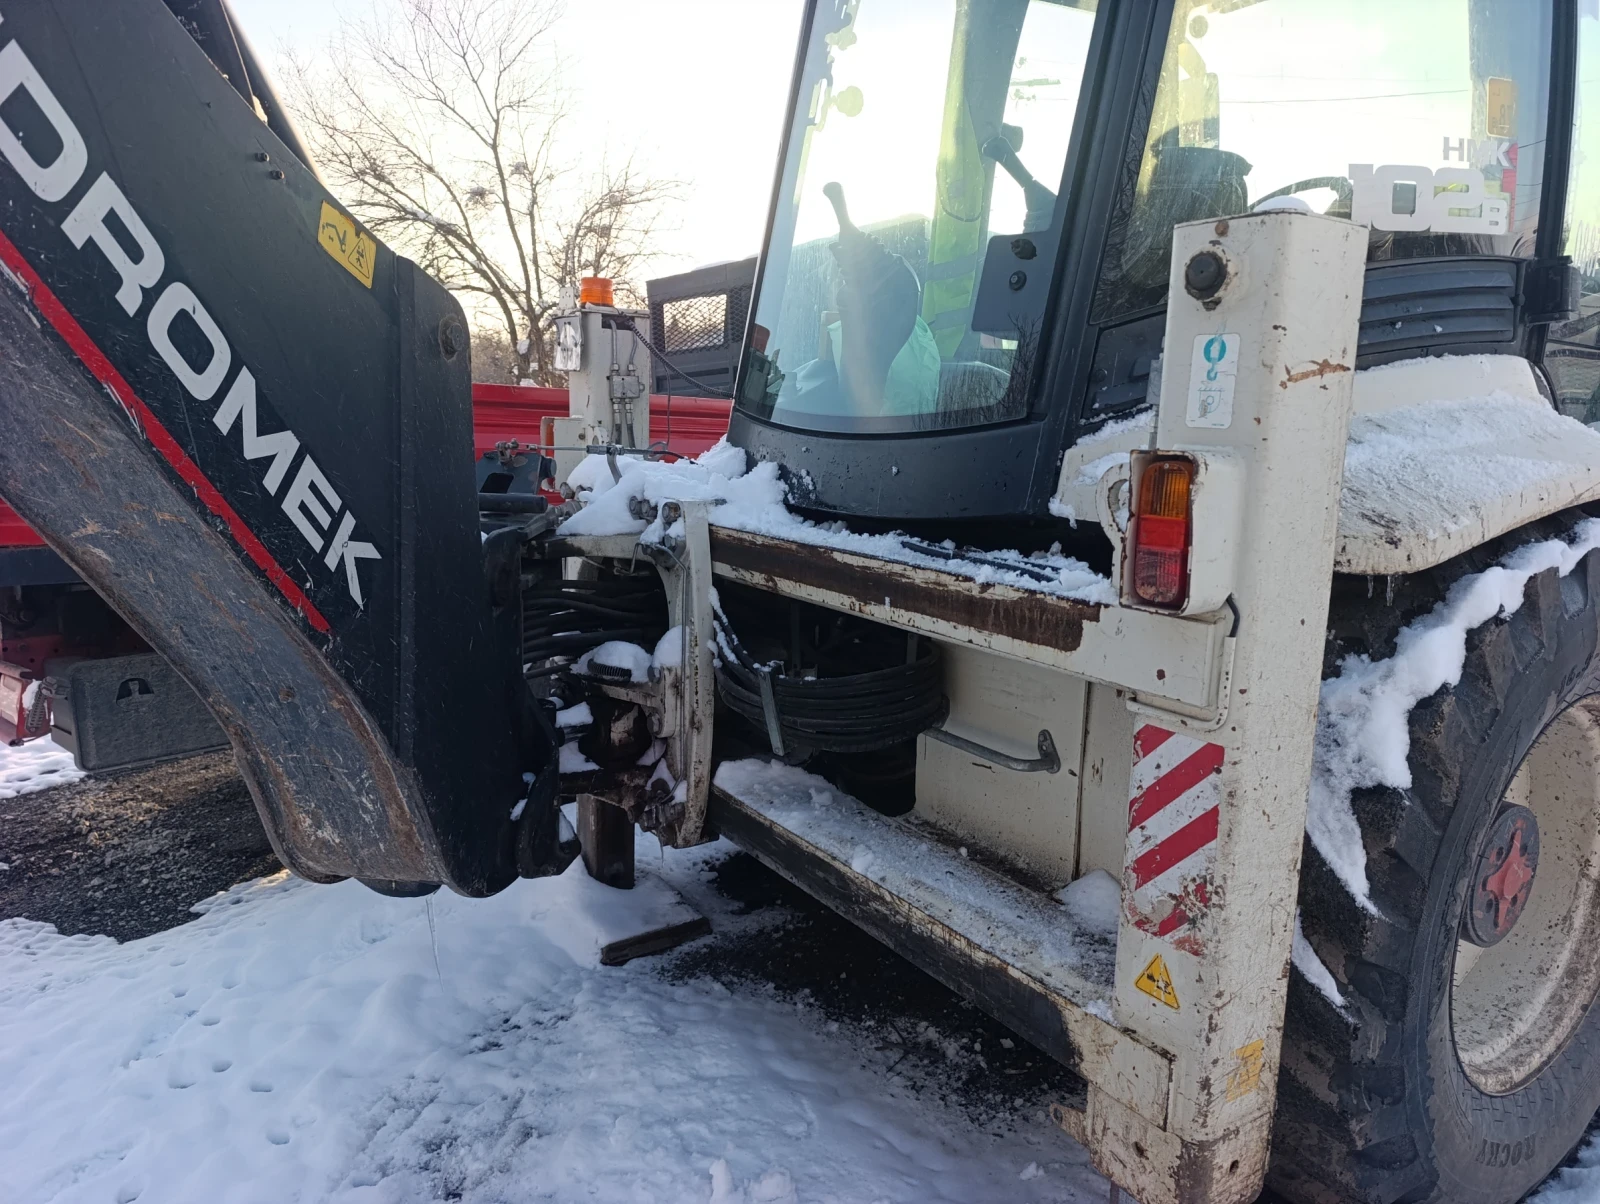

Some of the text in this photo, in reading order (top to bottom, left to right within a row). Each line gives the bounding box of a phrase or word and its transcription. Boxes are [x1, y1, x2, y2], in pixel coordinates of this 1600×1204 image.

[1443, 136, 1510, 167] HMK
[0, 12, 382, 610] DROMEK
[1475, 1133, 1536, 1168] ROCKY
